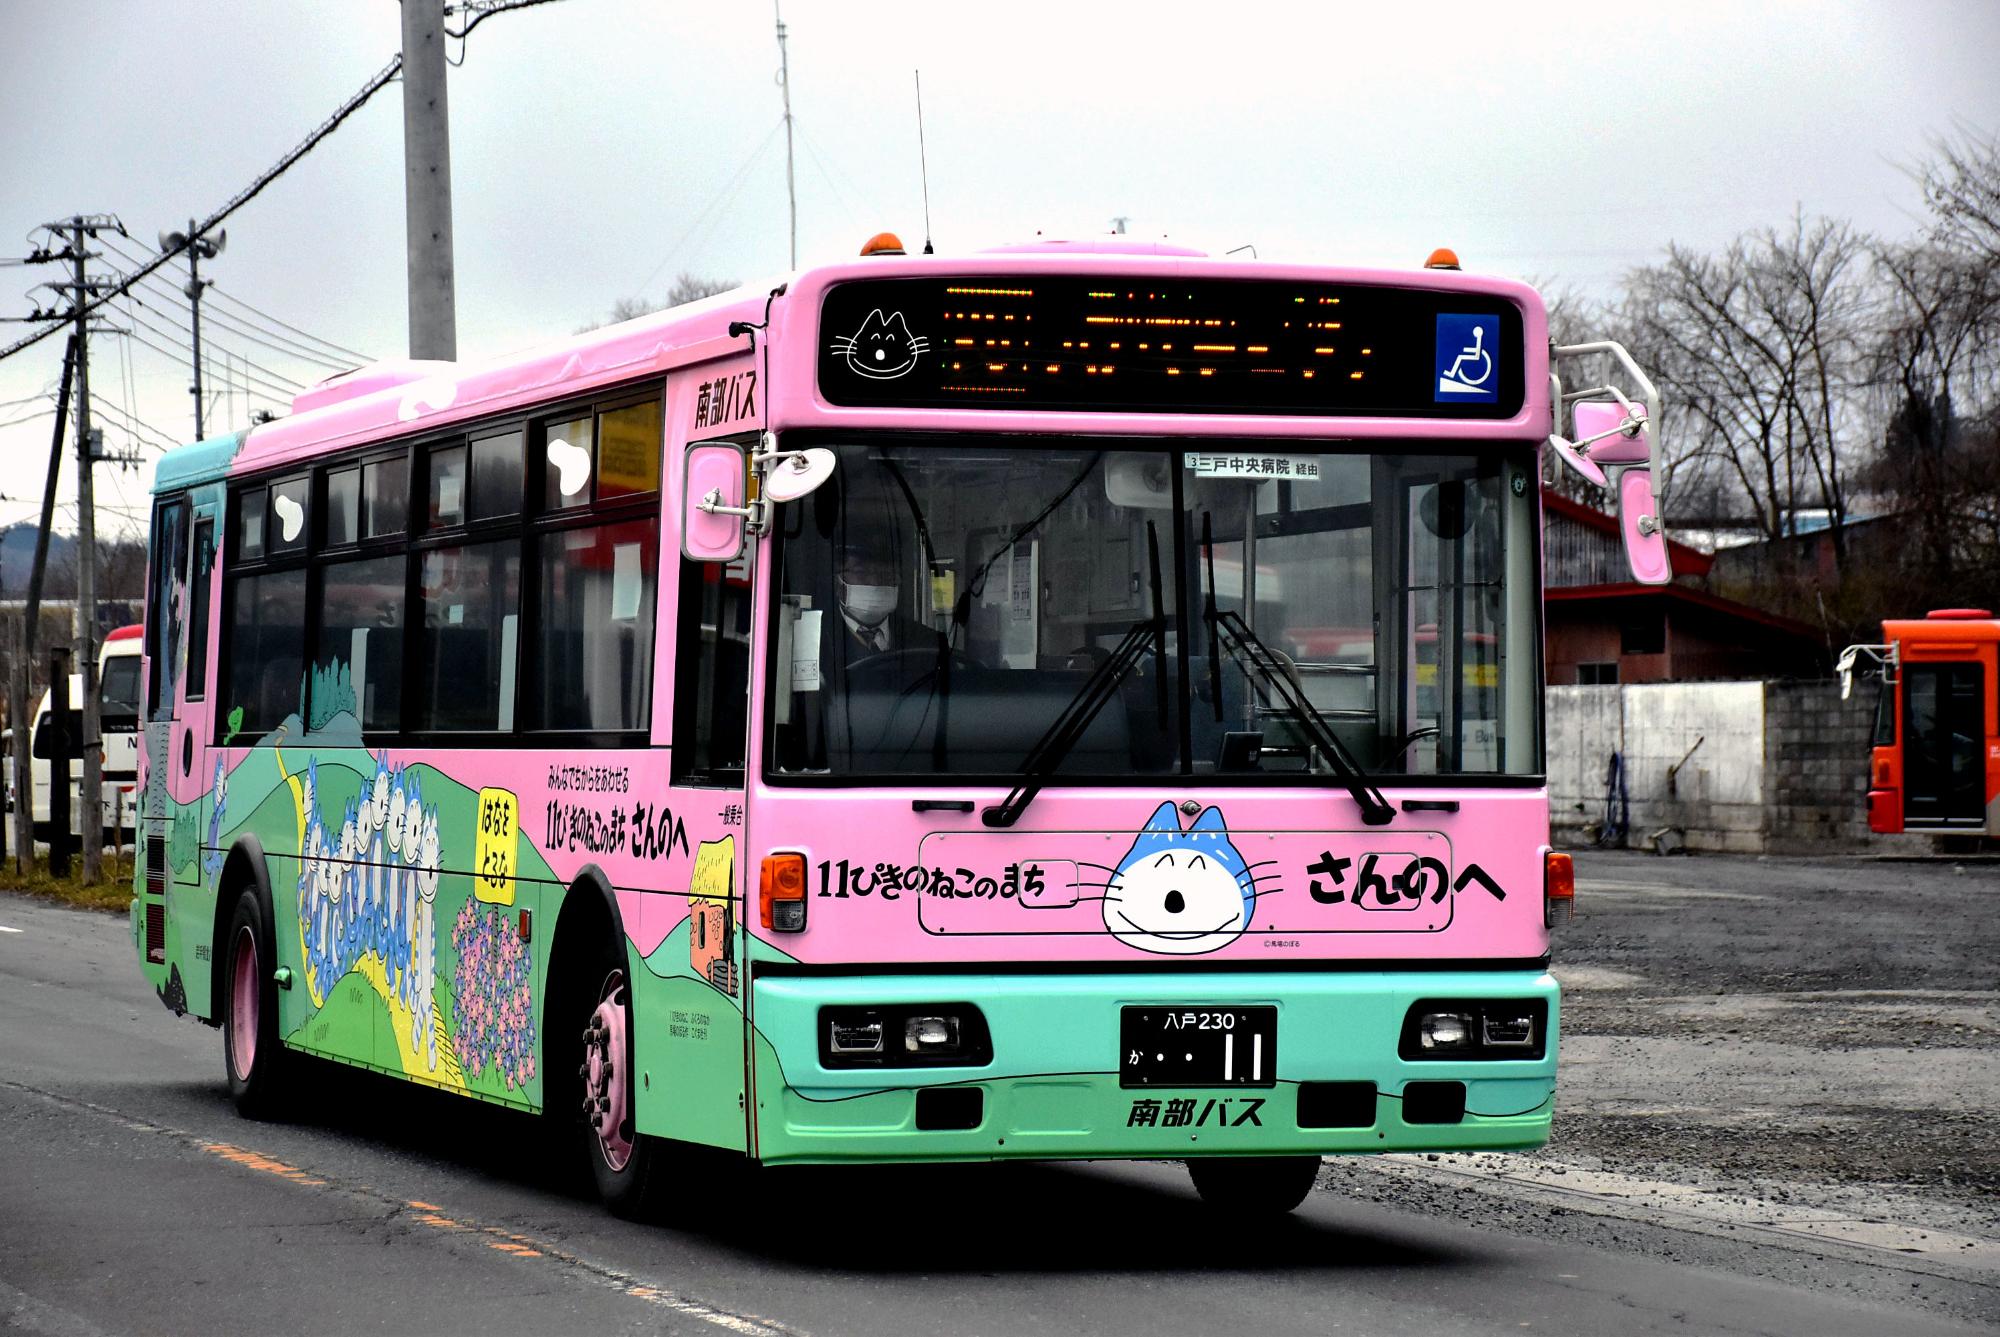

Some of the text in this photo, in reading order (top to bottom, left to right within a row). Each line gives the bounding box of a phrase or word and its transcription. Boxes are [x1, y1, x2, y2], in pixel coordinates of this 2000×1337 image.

[695, 370, 757, 430] 南部バス
[1196, 456, 1318, 476] 三戸中央病院 経由
[548, 764, 629, 793] みんなでちからをあわせる
[482, 796, 510, 837] はなを
[545, 799, 690, 861] 11ぴきのねこのまち さんのへ
[817, 850, 1507, 906] 11ぴきのねこのまち さんのへ
[1163, 1012, 1235, 1030] 八戸230
[1129, 1050, 1144, 1065] か
[1126, 1098, 1267, 1127] 南部バス
